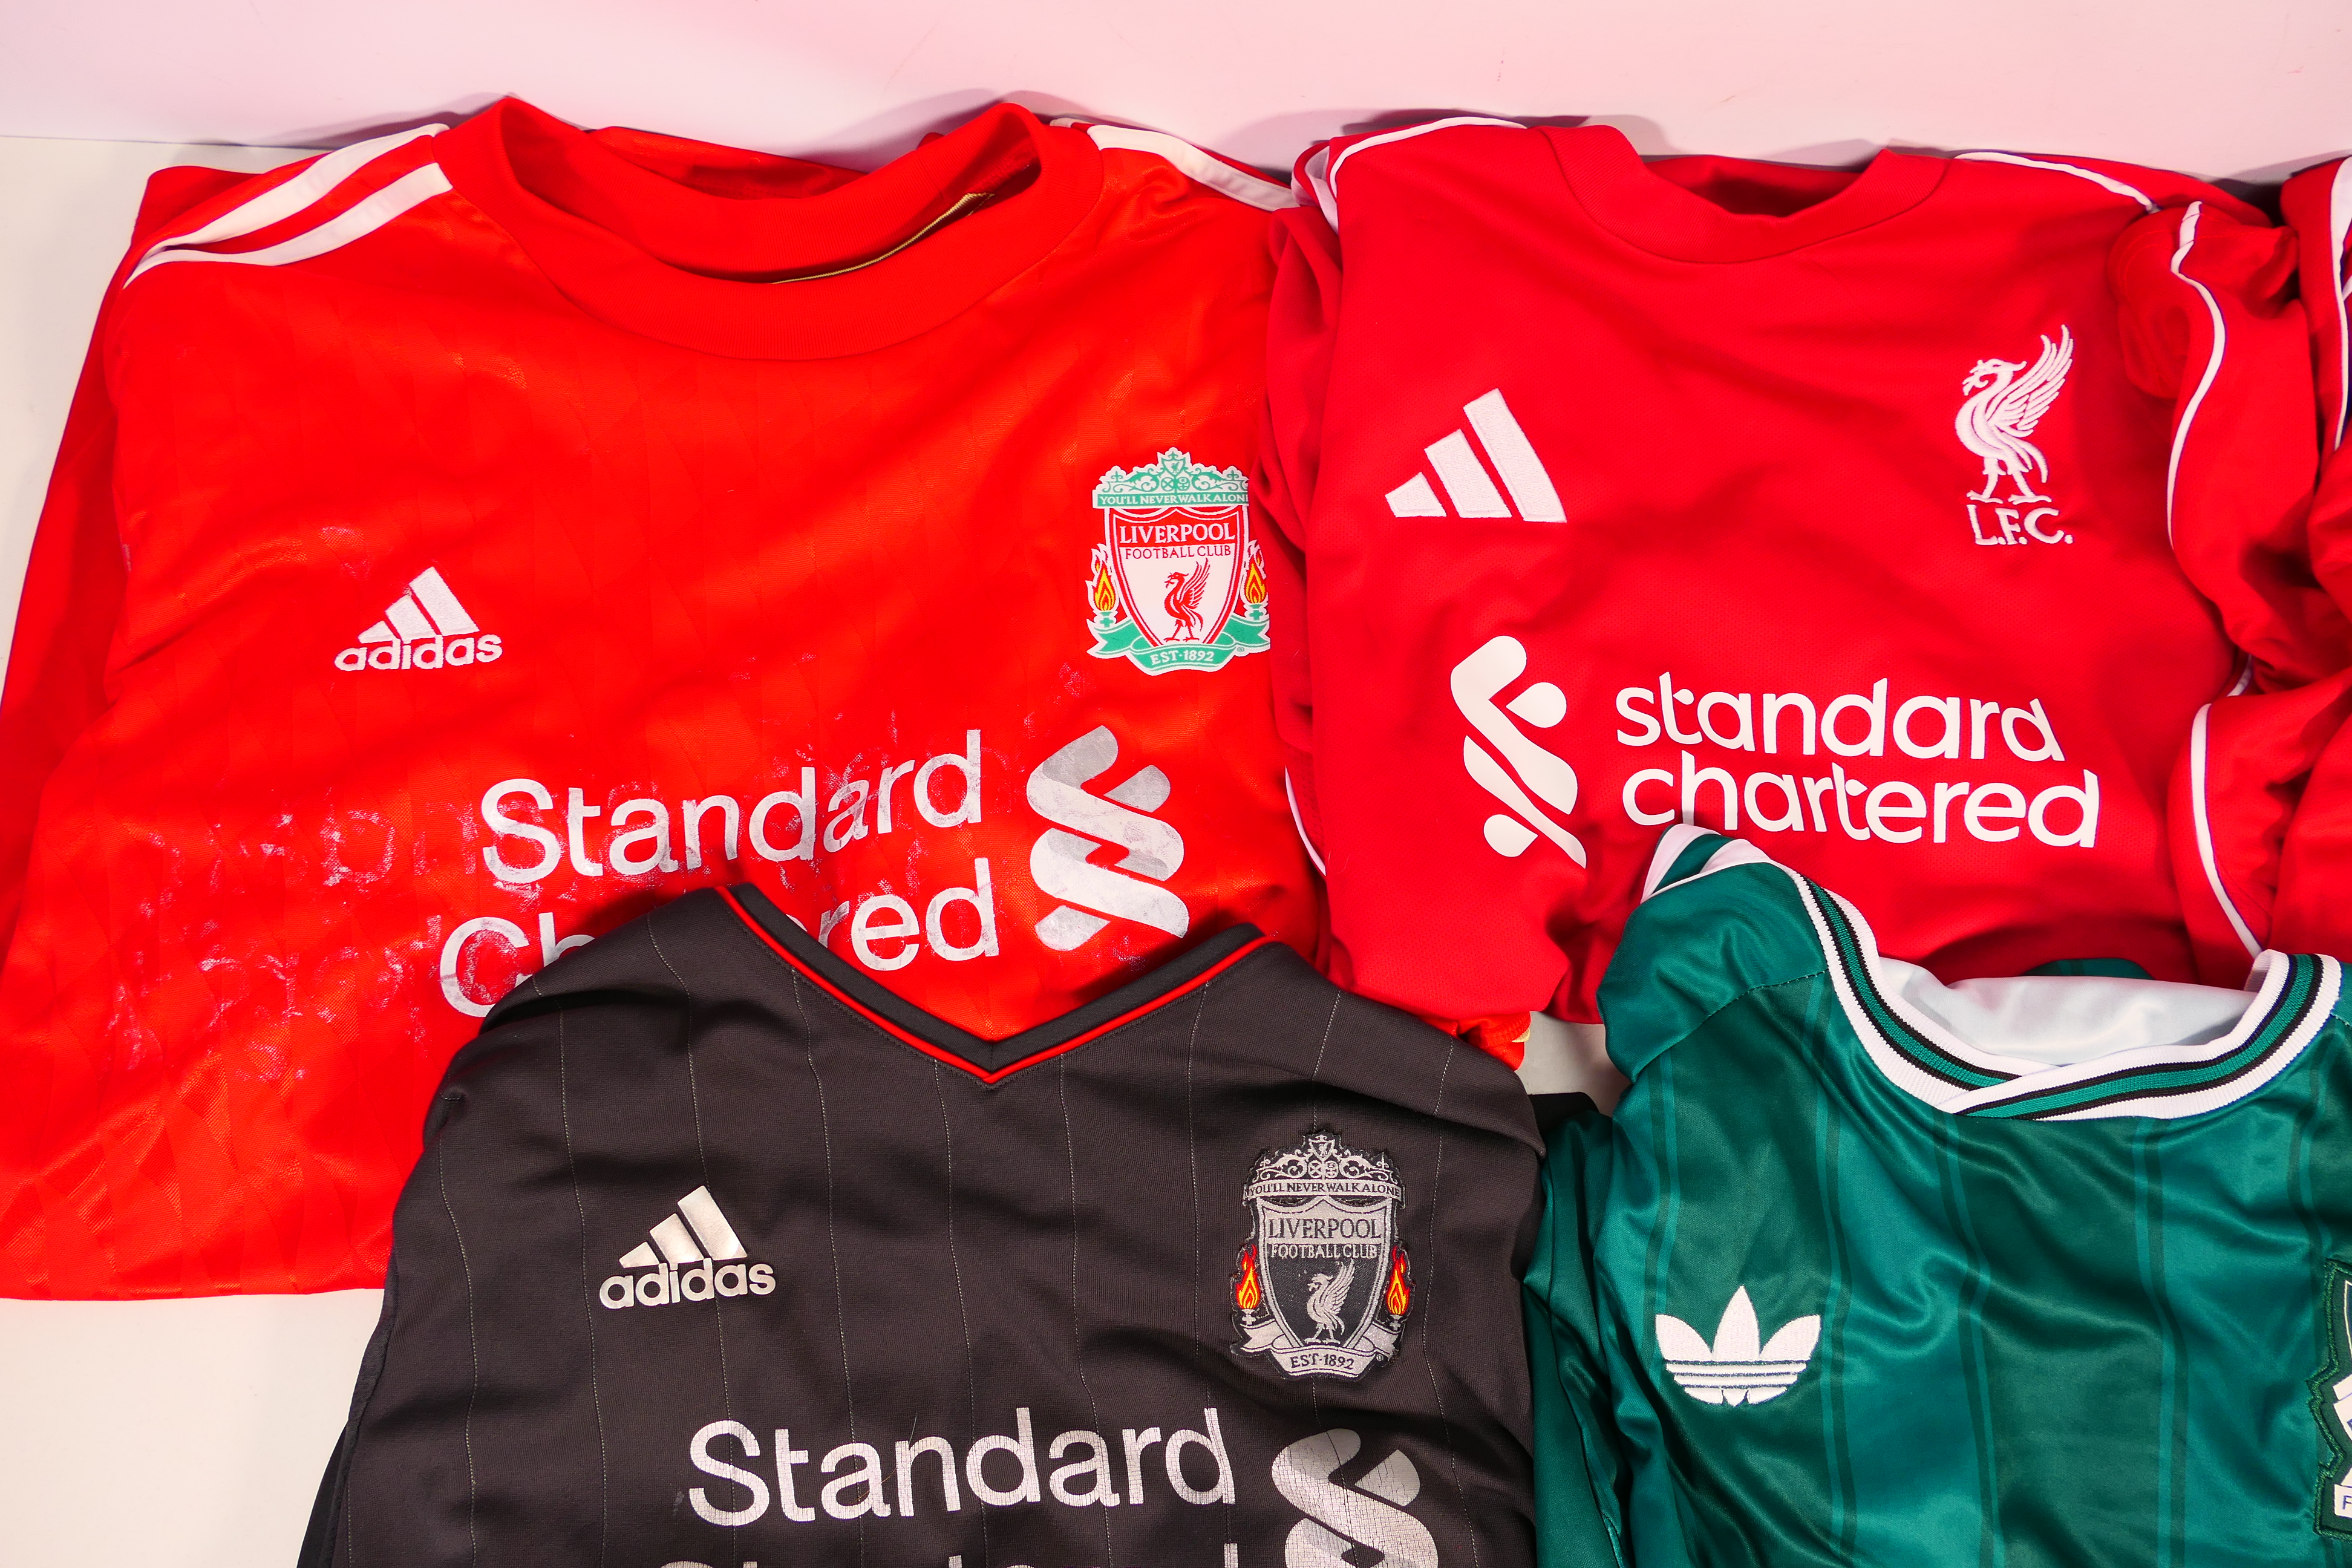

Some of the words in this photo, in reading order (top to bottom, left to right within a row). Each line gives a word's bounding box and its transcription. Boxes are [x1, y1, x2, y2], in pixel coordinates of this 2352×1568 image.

[1100, 495, 1138, 505] YOU'LL
[1141, 494, 1177, 503] NEVER
[1178, 493, 1210, 502] WALK
[1120, 523, 1235, 543] LIVERPOOL
[1966, 504, 2074, 545] L.F.C.
[1126, 548, 1195, 559] FOOTBALL
[1198, 546, 1231, 556] CLUB
[335, 634, 503, 671] adidas
[1615, 671, 2065, 762] standard
[482, 730, 982, 884] Standard
[1622, 750, 2099, 848] chartered
[1287, 1183, 1324, 1192] NEVER
[1325, 1183, 1361, 1192] WALK
[1362, 1184, 1400, 1197] ALONE
[1268, 1218, 1383, 1239] LIVERPOOL
[1270, 1244, 1341, 1259] FOOTBALL
[1342, 1244, 1378, 1259] CLUB
[599, 1258, 776, 1309] adidas
[688, 1407, 1236, 1526] Standard
